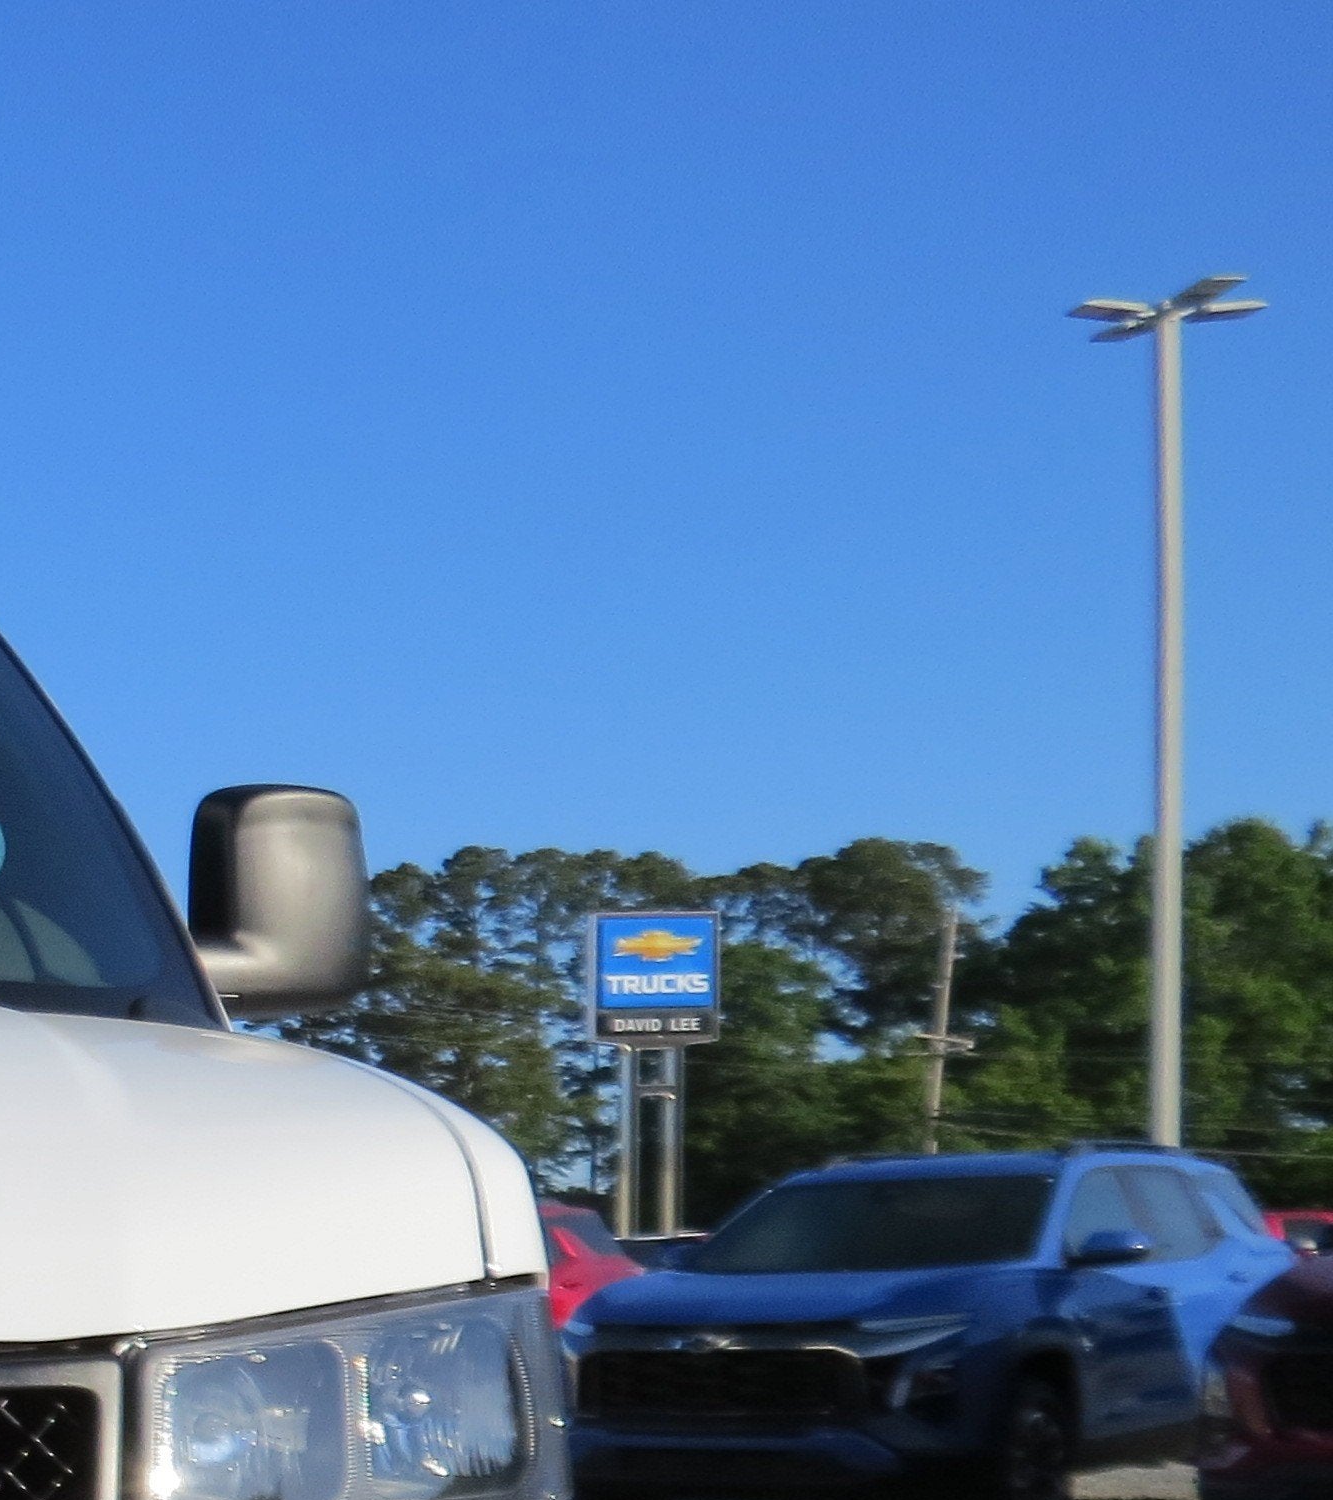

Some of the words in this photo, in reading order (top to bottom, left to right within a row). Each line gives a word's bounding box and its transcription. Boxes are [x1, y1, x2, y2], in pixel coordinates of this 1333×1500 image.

[606, 974, 709, 994] TRUCKS
[614, 1018, 663, 1032] DAVID
[670, 1018, 701, 1031] LEE
